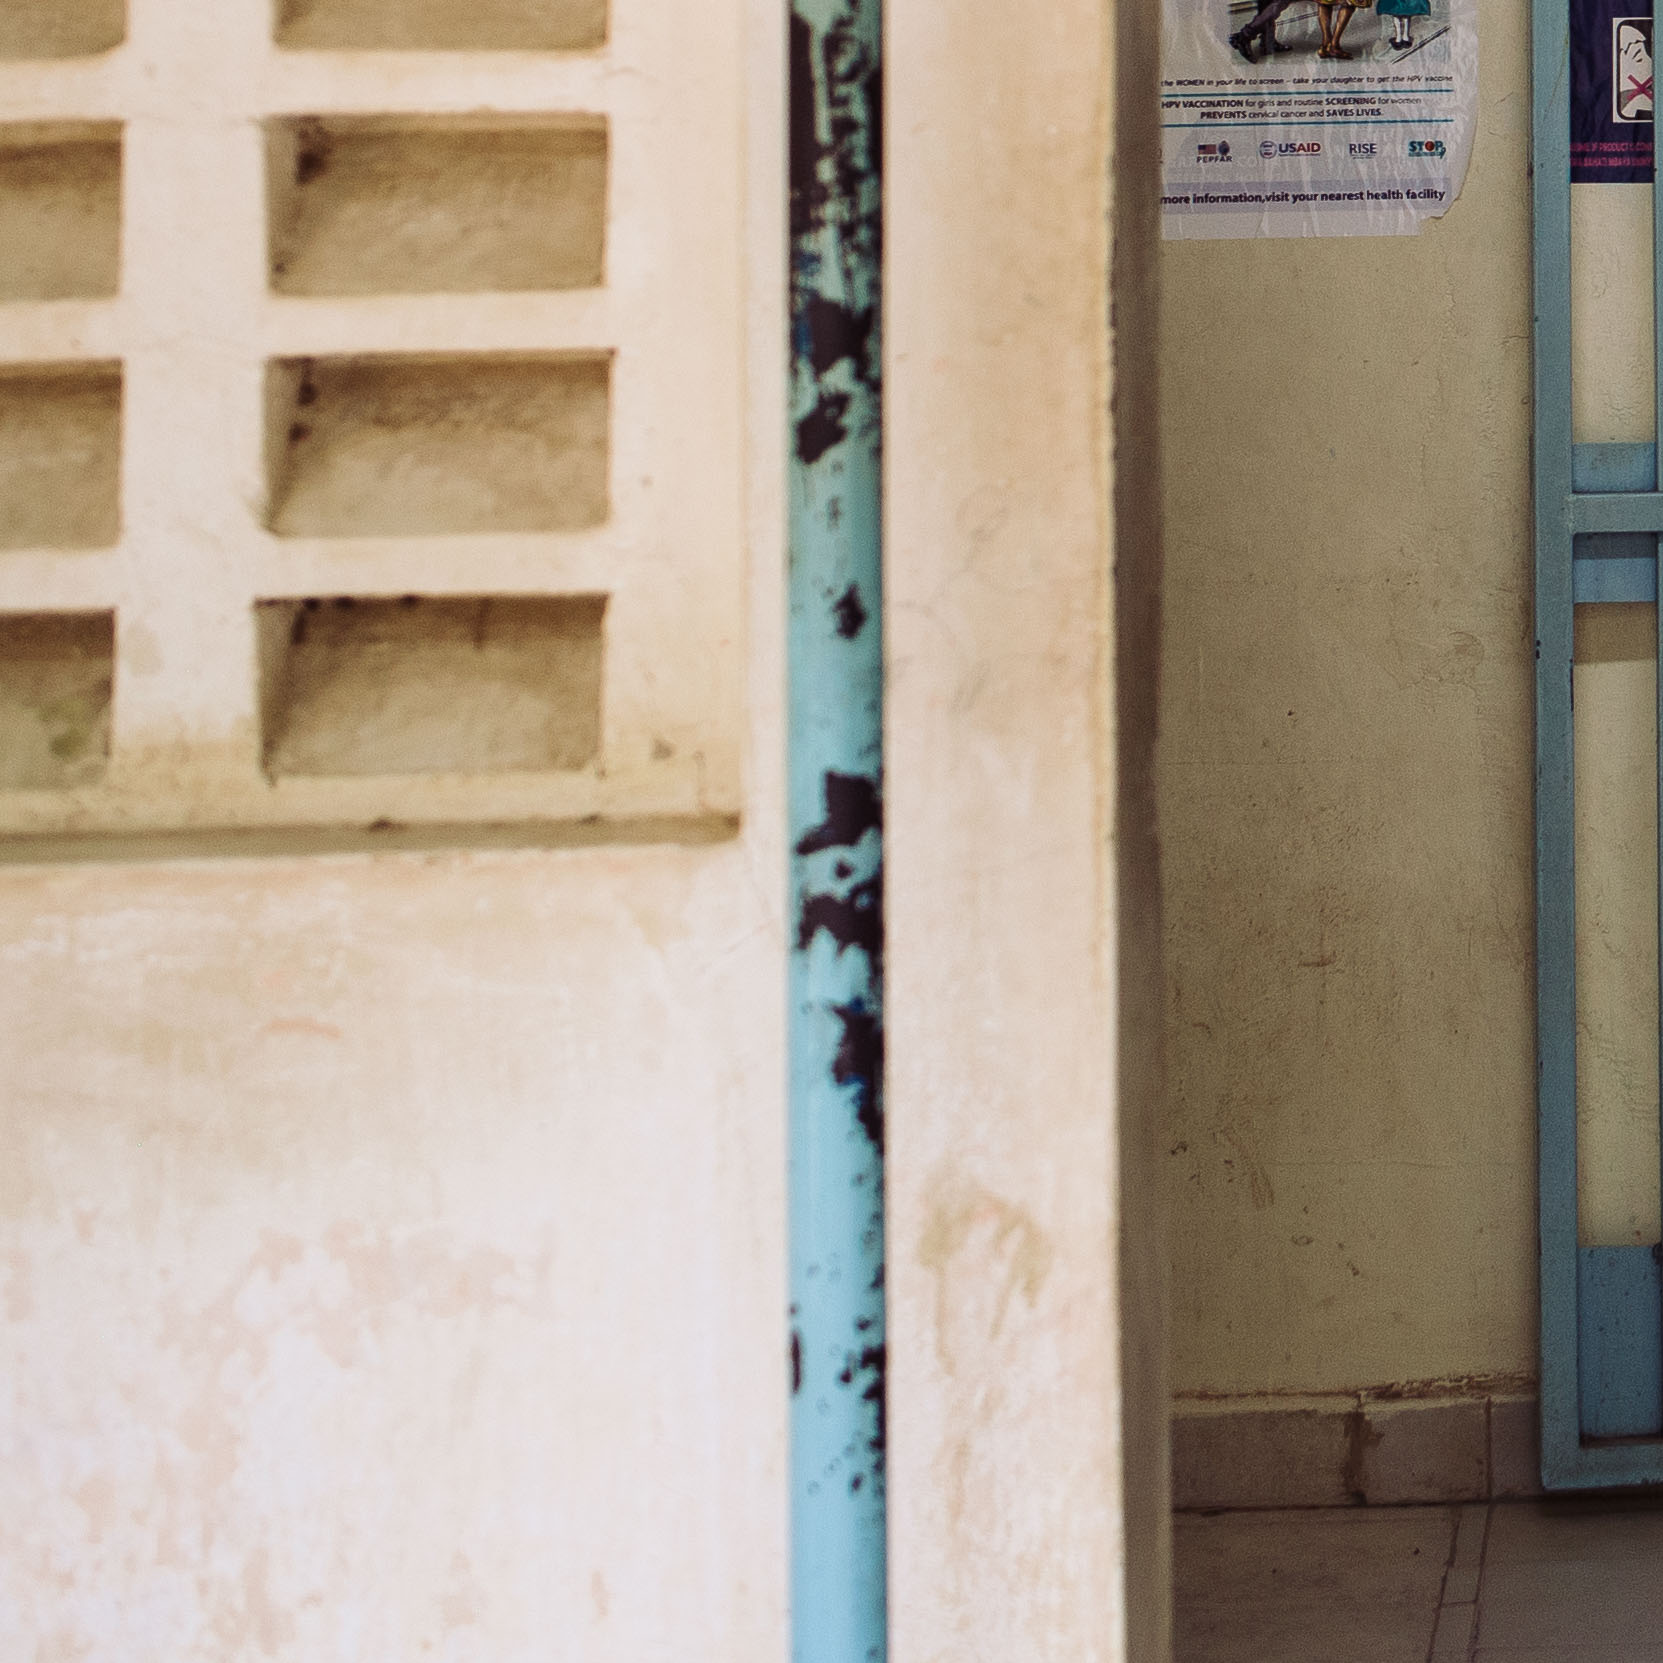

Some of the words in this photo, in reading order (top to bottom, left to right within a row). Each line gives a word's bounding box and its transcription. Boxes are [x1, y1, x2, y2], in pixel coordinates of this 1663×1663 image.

[1182, 99, 1243, 109] VACCINATION
[1245, 98, 1256, 107] for
[1277, 99, 1292, 107] and
[1325, 96, 1376, 105] SCREENING
[1378, 96, 1389, 104] for
[1200, 110, 1247, 120] PREVENTS
[1280, 110, 1307, 118] cancer
[1309, 109, 1324, 117] and
[1326, 108, 1354, 117] SAVES
[1279, 142, 1321, 153] USAID
[1350, 142, 1377, 154] RISE
[1196, 155, 1232, 163] PEPFAR
[1160, 193, 1190, 205] more
[1292, 192, 1319, 204] your
[1321, 190, 1364, 201] nearest
[1367, 189, 1403, 200] health
[1406, 188, 1445, 201] facility
